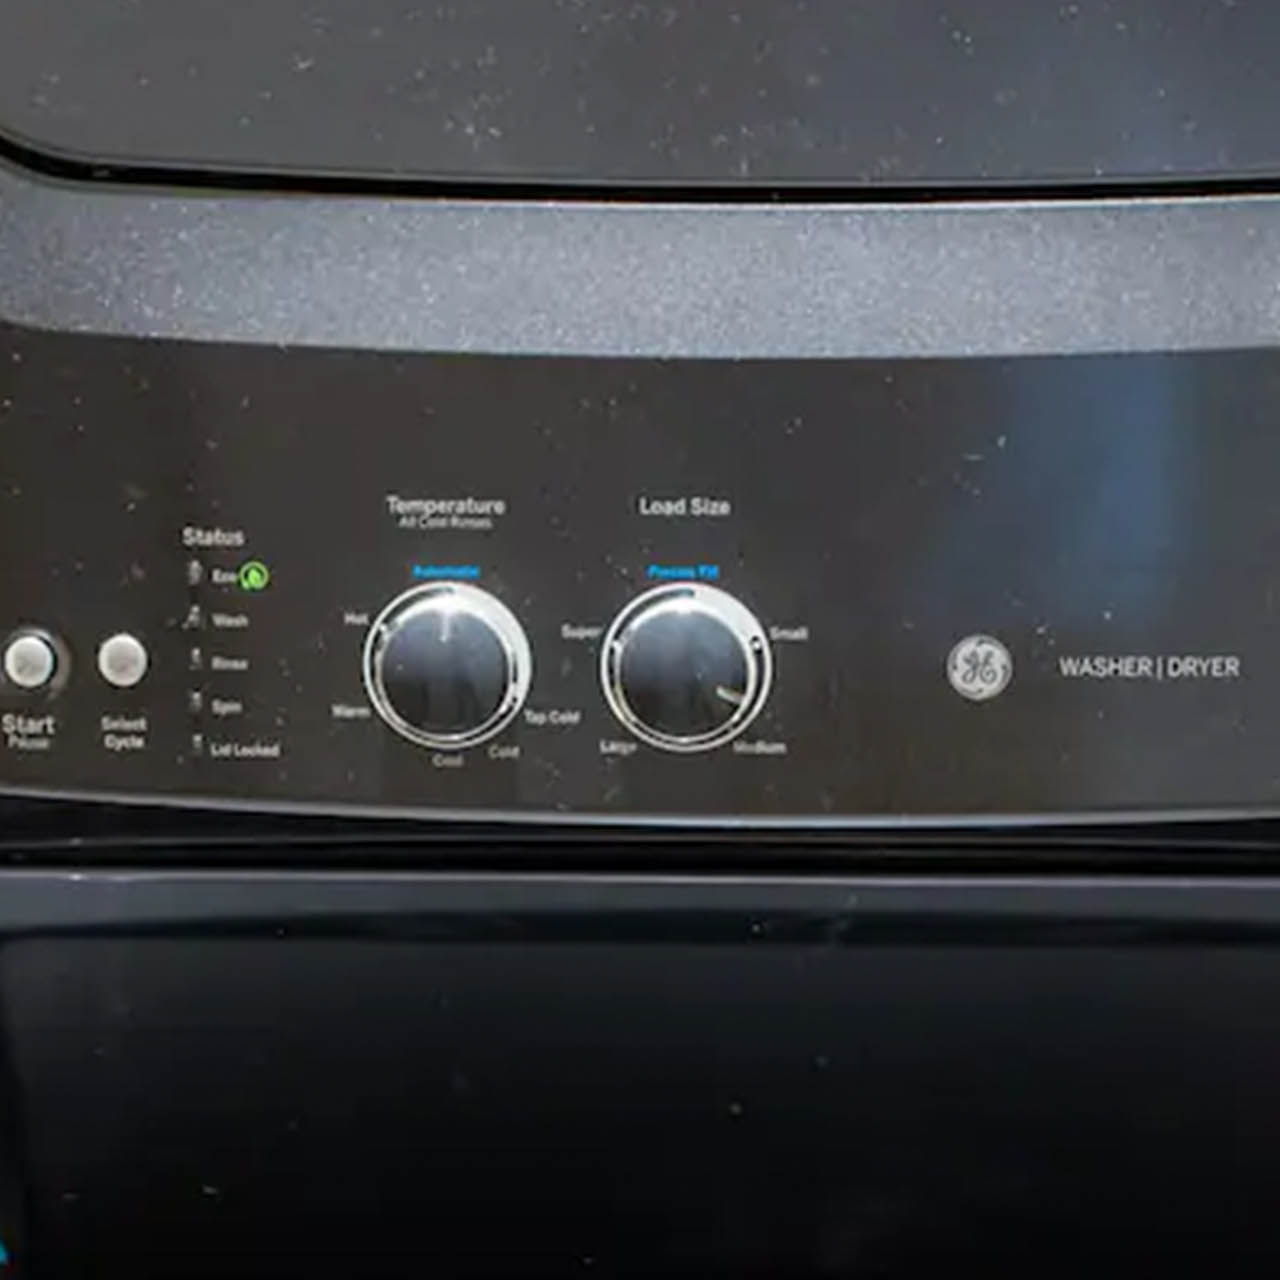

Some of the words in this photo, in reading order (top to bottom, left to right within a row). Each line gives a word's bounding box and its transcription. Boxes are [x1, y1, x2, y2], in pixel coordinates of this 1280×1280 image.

[386, 496, 507, 518] Temperature
[639, 498, 687, 516] Load
[690, 498, 731, 516] Size
[182, 526, 246, 546] Status
[211, 613, 249, 628] Wash
[561, 624, 603, 642] Super
[769, 626, 809, 641] Small
[211, 656, 248, 671] Rinse
[1, 713, 56, 735] Start
[100, 716, 148, 732] Select
[547, 710, 581, 724] Cold
[104, 734, 145, 751] Cycle
[234, 742, 281, 757] Locked
